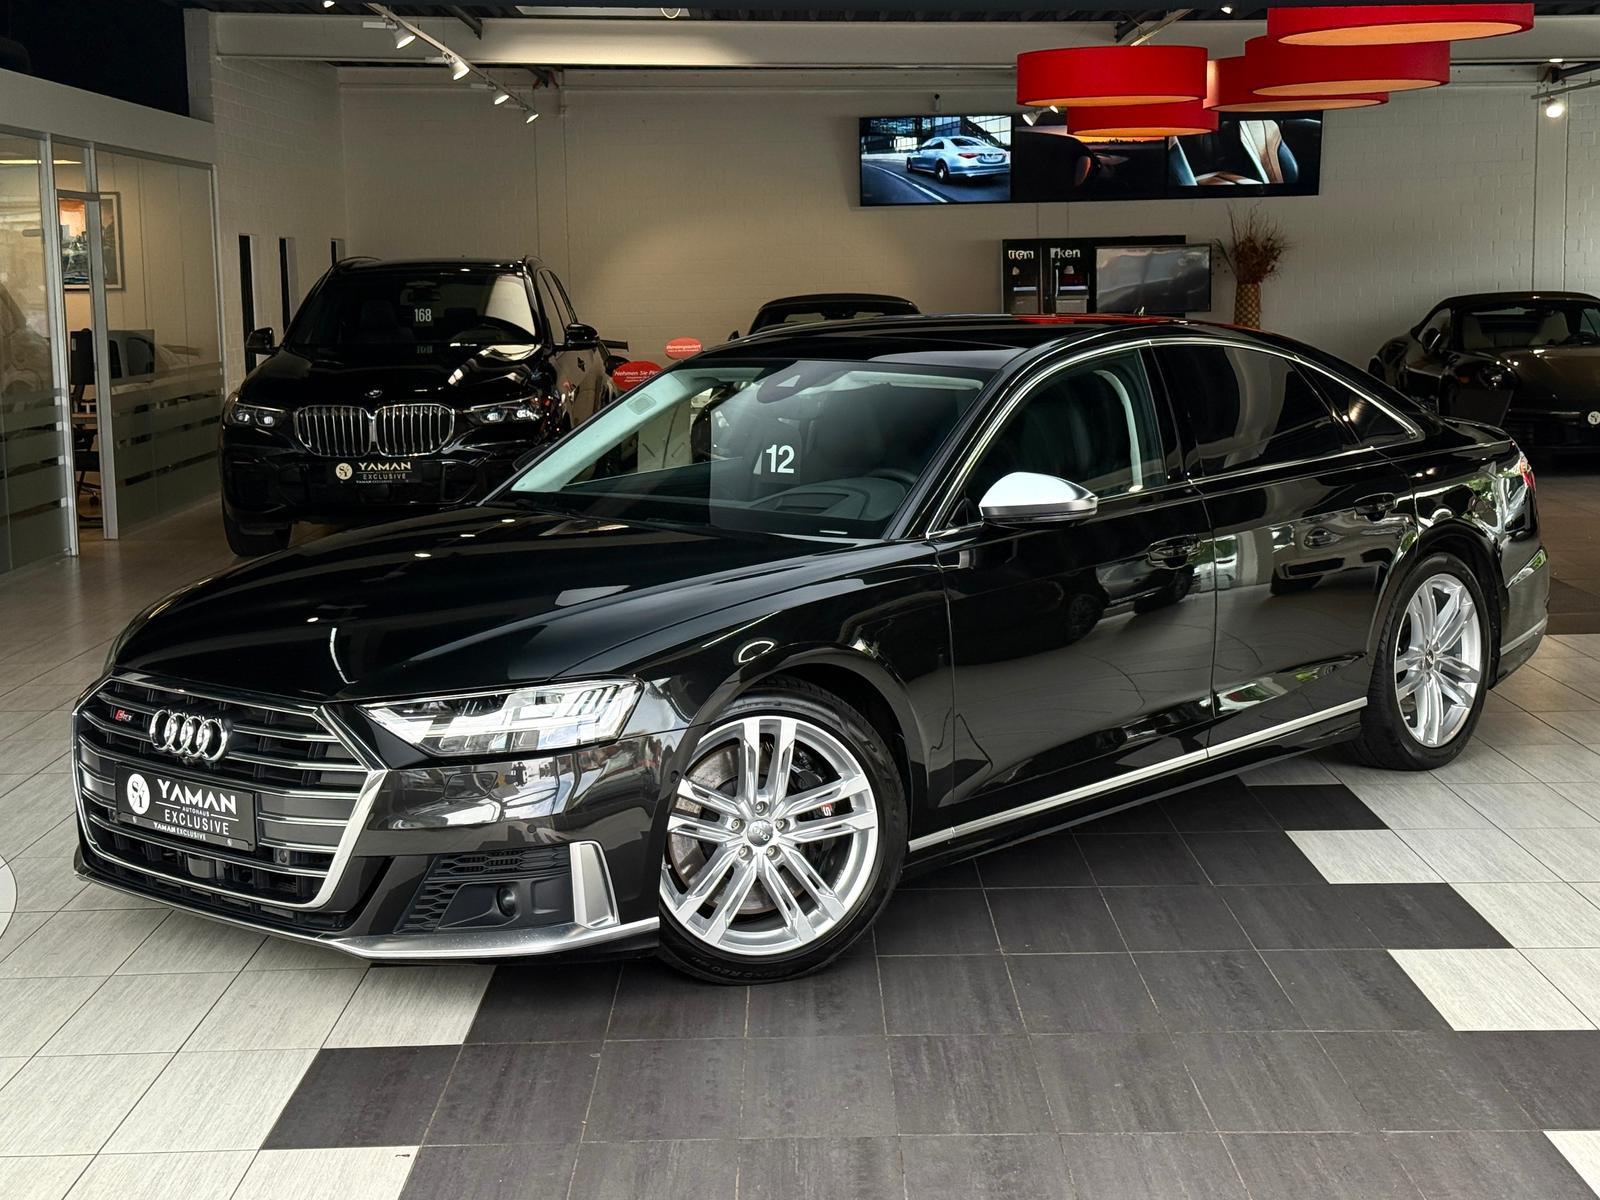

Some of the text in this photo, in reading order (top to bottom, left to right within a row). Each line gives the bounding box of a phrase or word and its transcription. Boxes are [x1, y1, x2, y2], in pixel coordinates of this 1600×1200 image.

[414, 308, 432, 322] 168
[358, 462, 412, 471] YAMAN
[765, 444, 795, 474] 12
[157, 778, 237, 815] YAMAN
[181, 806, 210, 817] AUTOHAUS
[153, 821, 207, 841] YAMAN EXCLUSIVE
[164, 809, 230, 836] EXCLUSIVE
